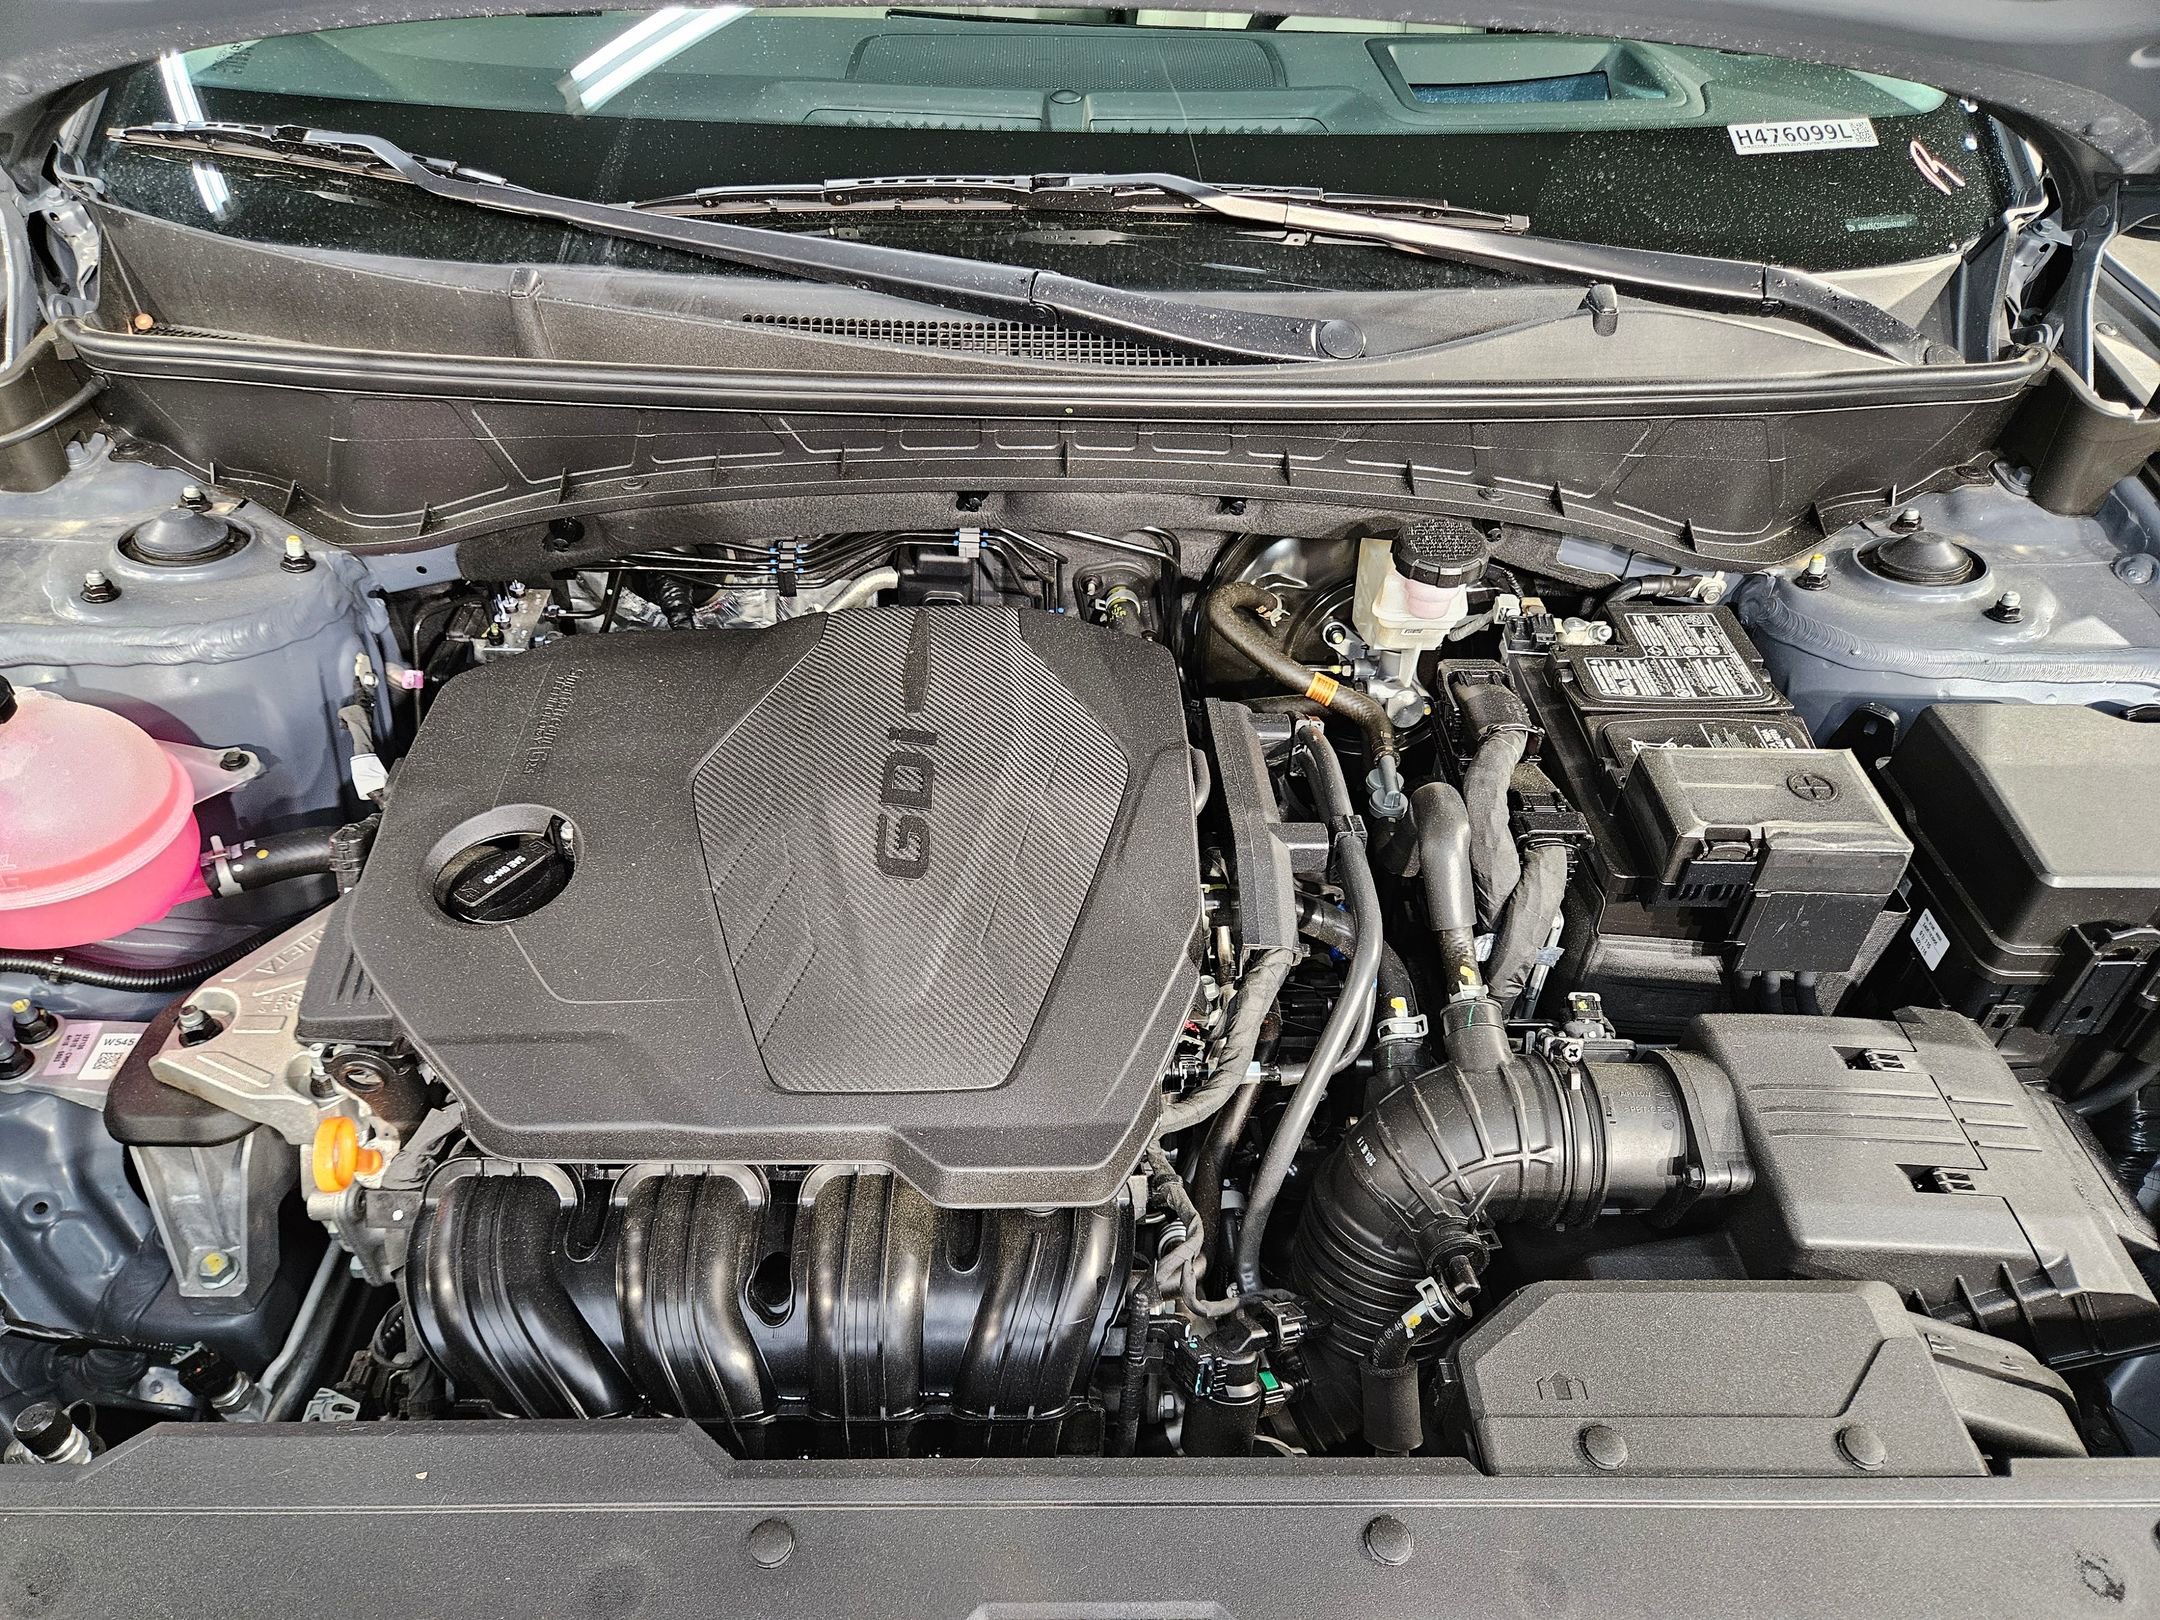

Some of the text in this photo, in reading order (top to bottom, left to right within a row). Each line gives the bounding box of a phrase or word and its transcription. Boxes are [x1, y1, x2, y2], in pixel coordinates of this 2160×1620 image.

[1735, 123, 1853, 146] H476099L
[506, 855, 527, 868] SAE
[104, 1038, 136, 1046] W545
